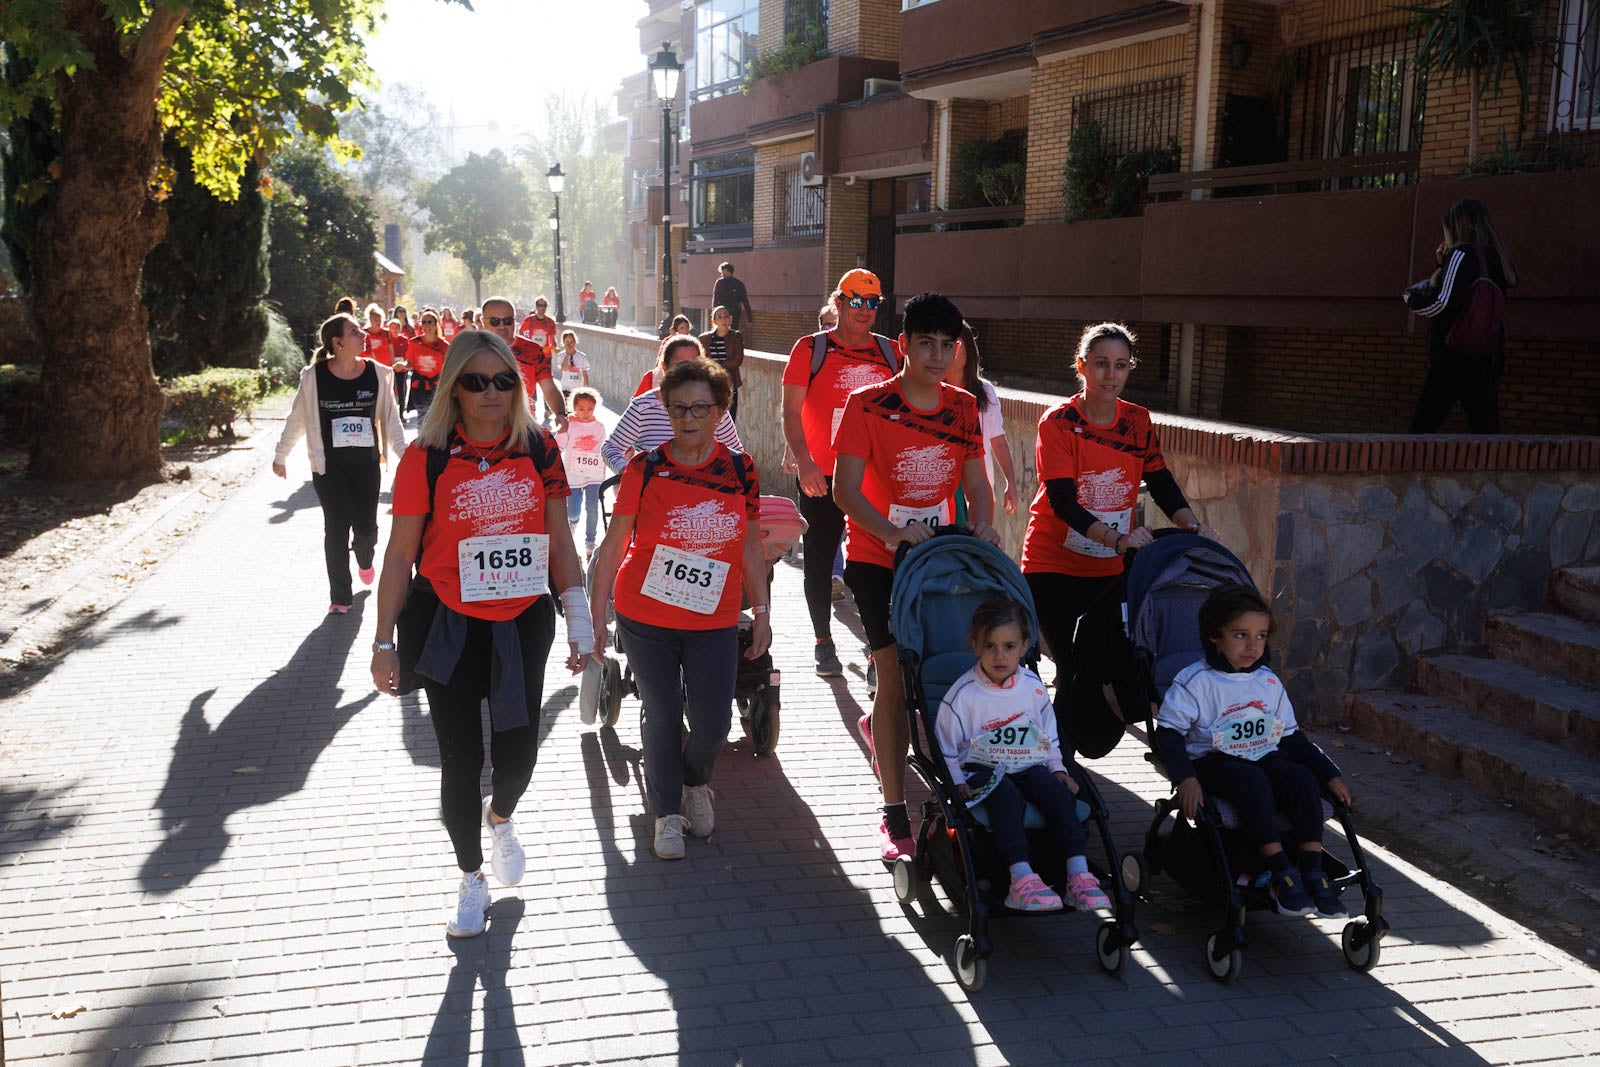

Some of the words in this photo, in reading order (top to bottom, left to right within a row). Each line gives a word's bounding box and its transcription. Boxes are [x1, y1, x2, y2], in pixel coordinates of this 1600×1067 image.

[841, 374, 882, 382] carrera
[342, 423, 363, 433] 209
[577, 456, 599, 467] 1560
[897, 461, 952, 472] carrera
[455, 482, 531, 507] carrera
[1080, 484, 1128, 497] carrera
[459, 499, 534, 520] cruzroja.es
[669, 515, 736, 529] carrera
[670, 529, 737, 540] cruzroja.es
[474, 548, 532, 570] 1658
[664, 560, 713, 587] 1653
[989, 727, 1030, 745] 397
[1231, 719, 1265, 741] 396
[1229, 742, 1248, 750] RAFAEL
